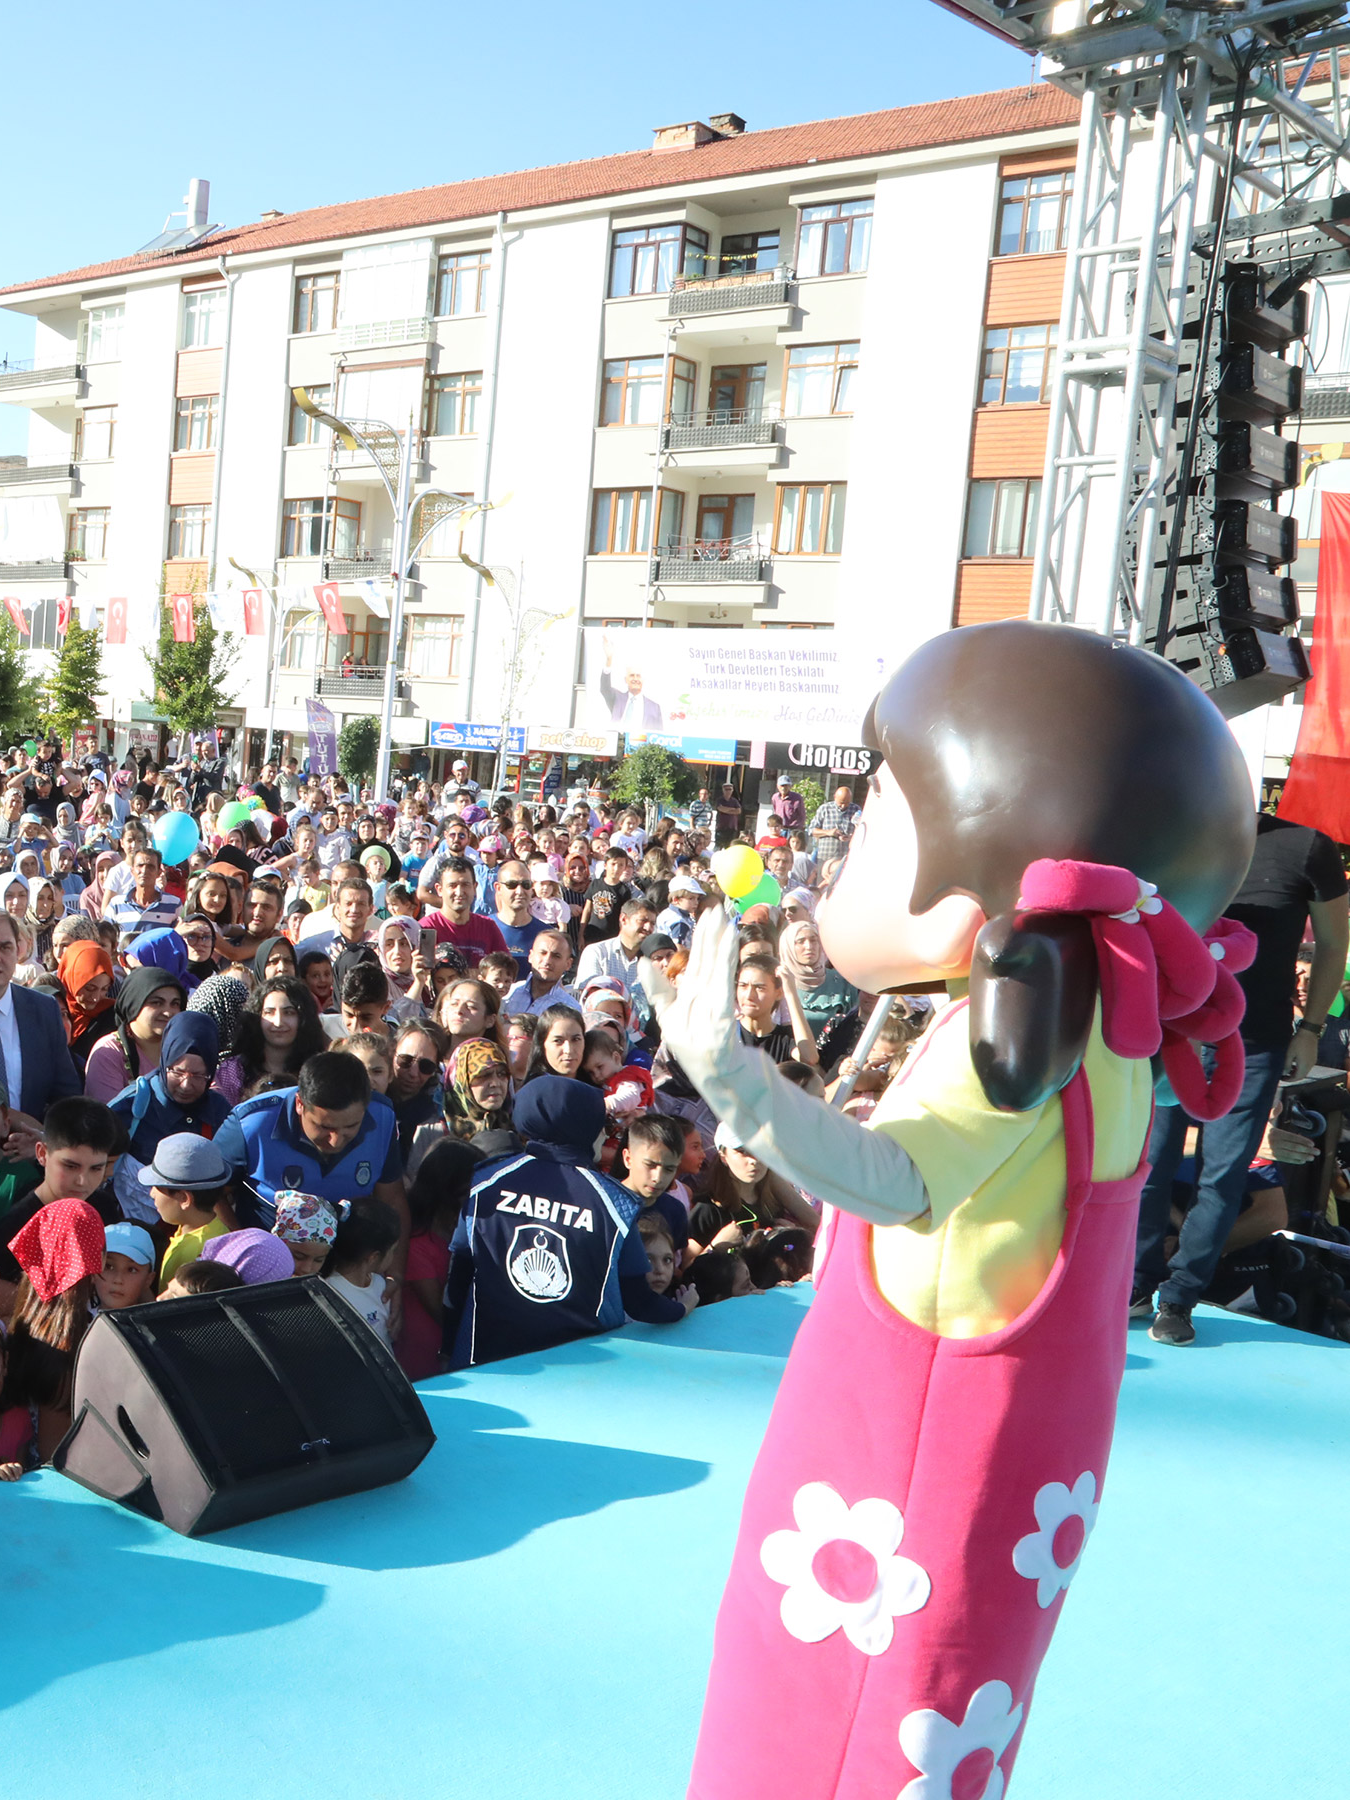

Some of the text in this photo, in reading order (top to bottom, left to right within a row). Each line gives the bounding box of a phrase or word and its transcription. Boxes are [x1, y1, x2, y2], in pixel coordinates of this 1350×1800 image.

[689, 648, 716, 661] Sayın
[718, 648, 746, 660] Genel
[749, 649, 787, 662] Başkan
[728, 664, 777, 676] Devletleri
[690, 678, 742, 690] Aksakallar
[744, 679, 776, 692] Heyeti
[574, 731, 607, 751] shop
[649, 734, 683, 747] Coral
[496, 1190, 594, 1232] ZABITA
